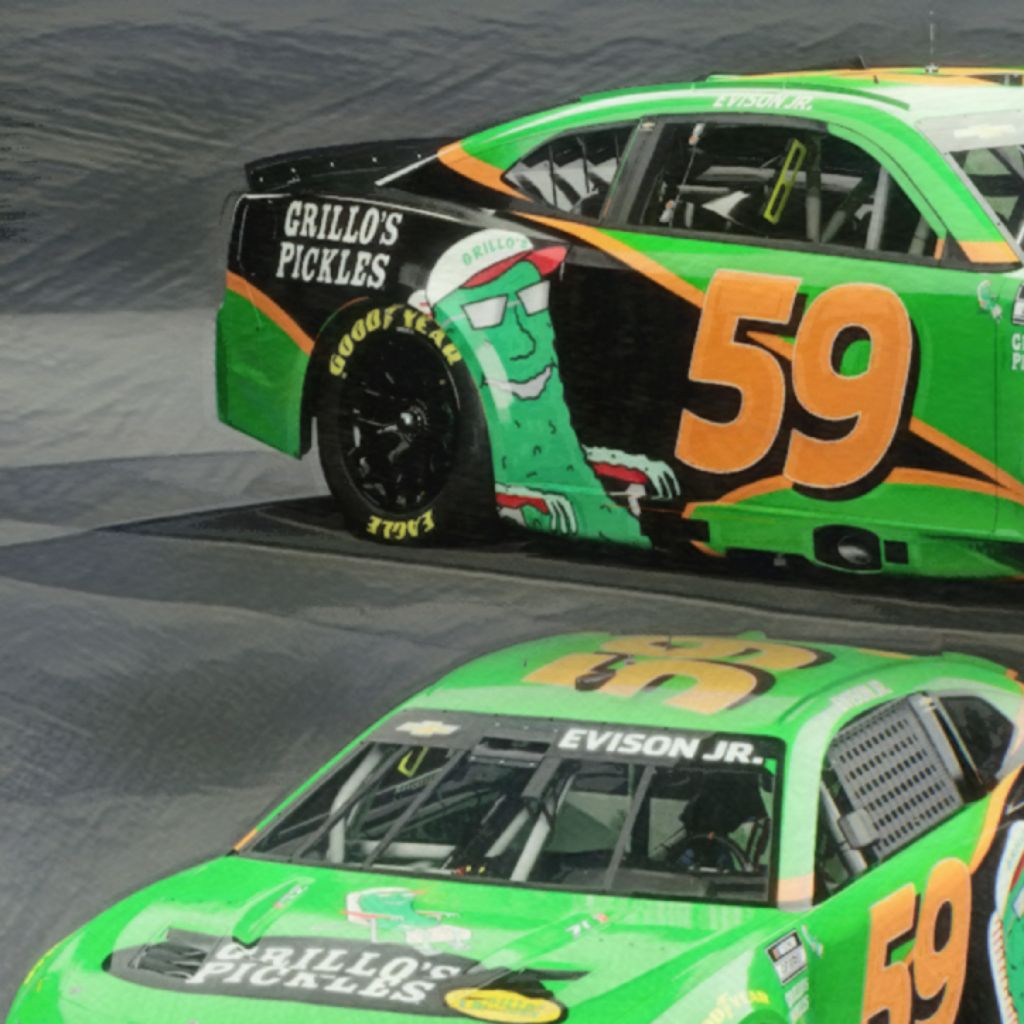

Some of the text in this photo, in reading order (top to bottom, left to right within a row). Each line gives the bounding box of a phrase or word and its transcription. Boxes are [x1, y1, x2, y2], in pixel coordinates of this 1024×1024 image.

[284, 200, 403, 246] GRILLO'S
[276, 241, 390, 289] PICKLES
[674, 268, 915, 490] 59
[558, 728, 764, 763] EVISON JR.
